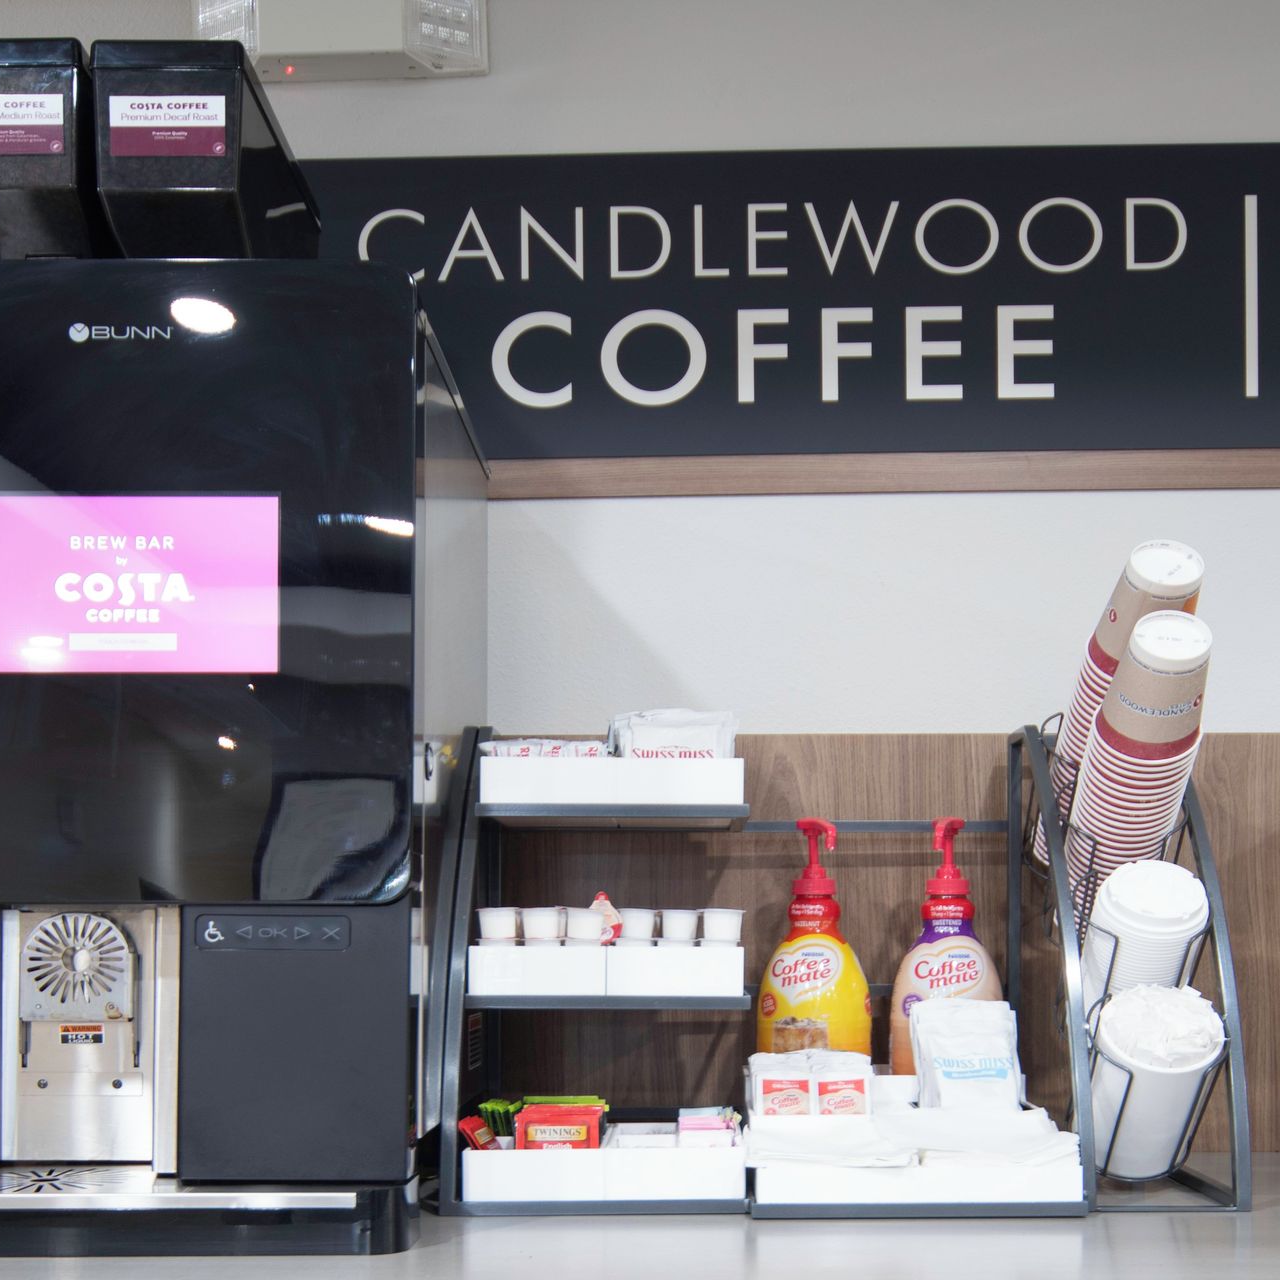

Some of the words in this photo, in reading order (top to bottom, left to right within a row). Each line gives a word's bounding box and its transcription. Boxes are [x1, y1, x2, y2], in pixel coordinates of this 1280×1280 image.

[4, 101, 46, 109] COFFEE
[35, 111, 60, 119] Roast
[120, 113, 162, 121] Premium
[164, 112, 190, 121] Decaf
[192, 112, 219, 121] Roast
[357, 196, 1187, 282] CANDLEWOOD
[91, 325, 171, 340] BUNN
[491, 304, 1056, 408] COFFEE
[70, 536, 126, 550] BREW
[135, 536, 175, 550] BAR
[116, 556, 128, 567] by
[54, 572, 196, 606] COSTA
[86, 608, 160, 623] COFFEE
[1119, 692, 1192, 717] CANDLEWOOD
[258, 926, 287, 940] OK
[772, 958, 831, 978] Coffee
[914, 960, 977, 980] Coffee
[781, 968, 832, 988] mate
[929, 969, 979, 989] mate
[534, 1127, 582, 1137] TWININGS
